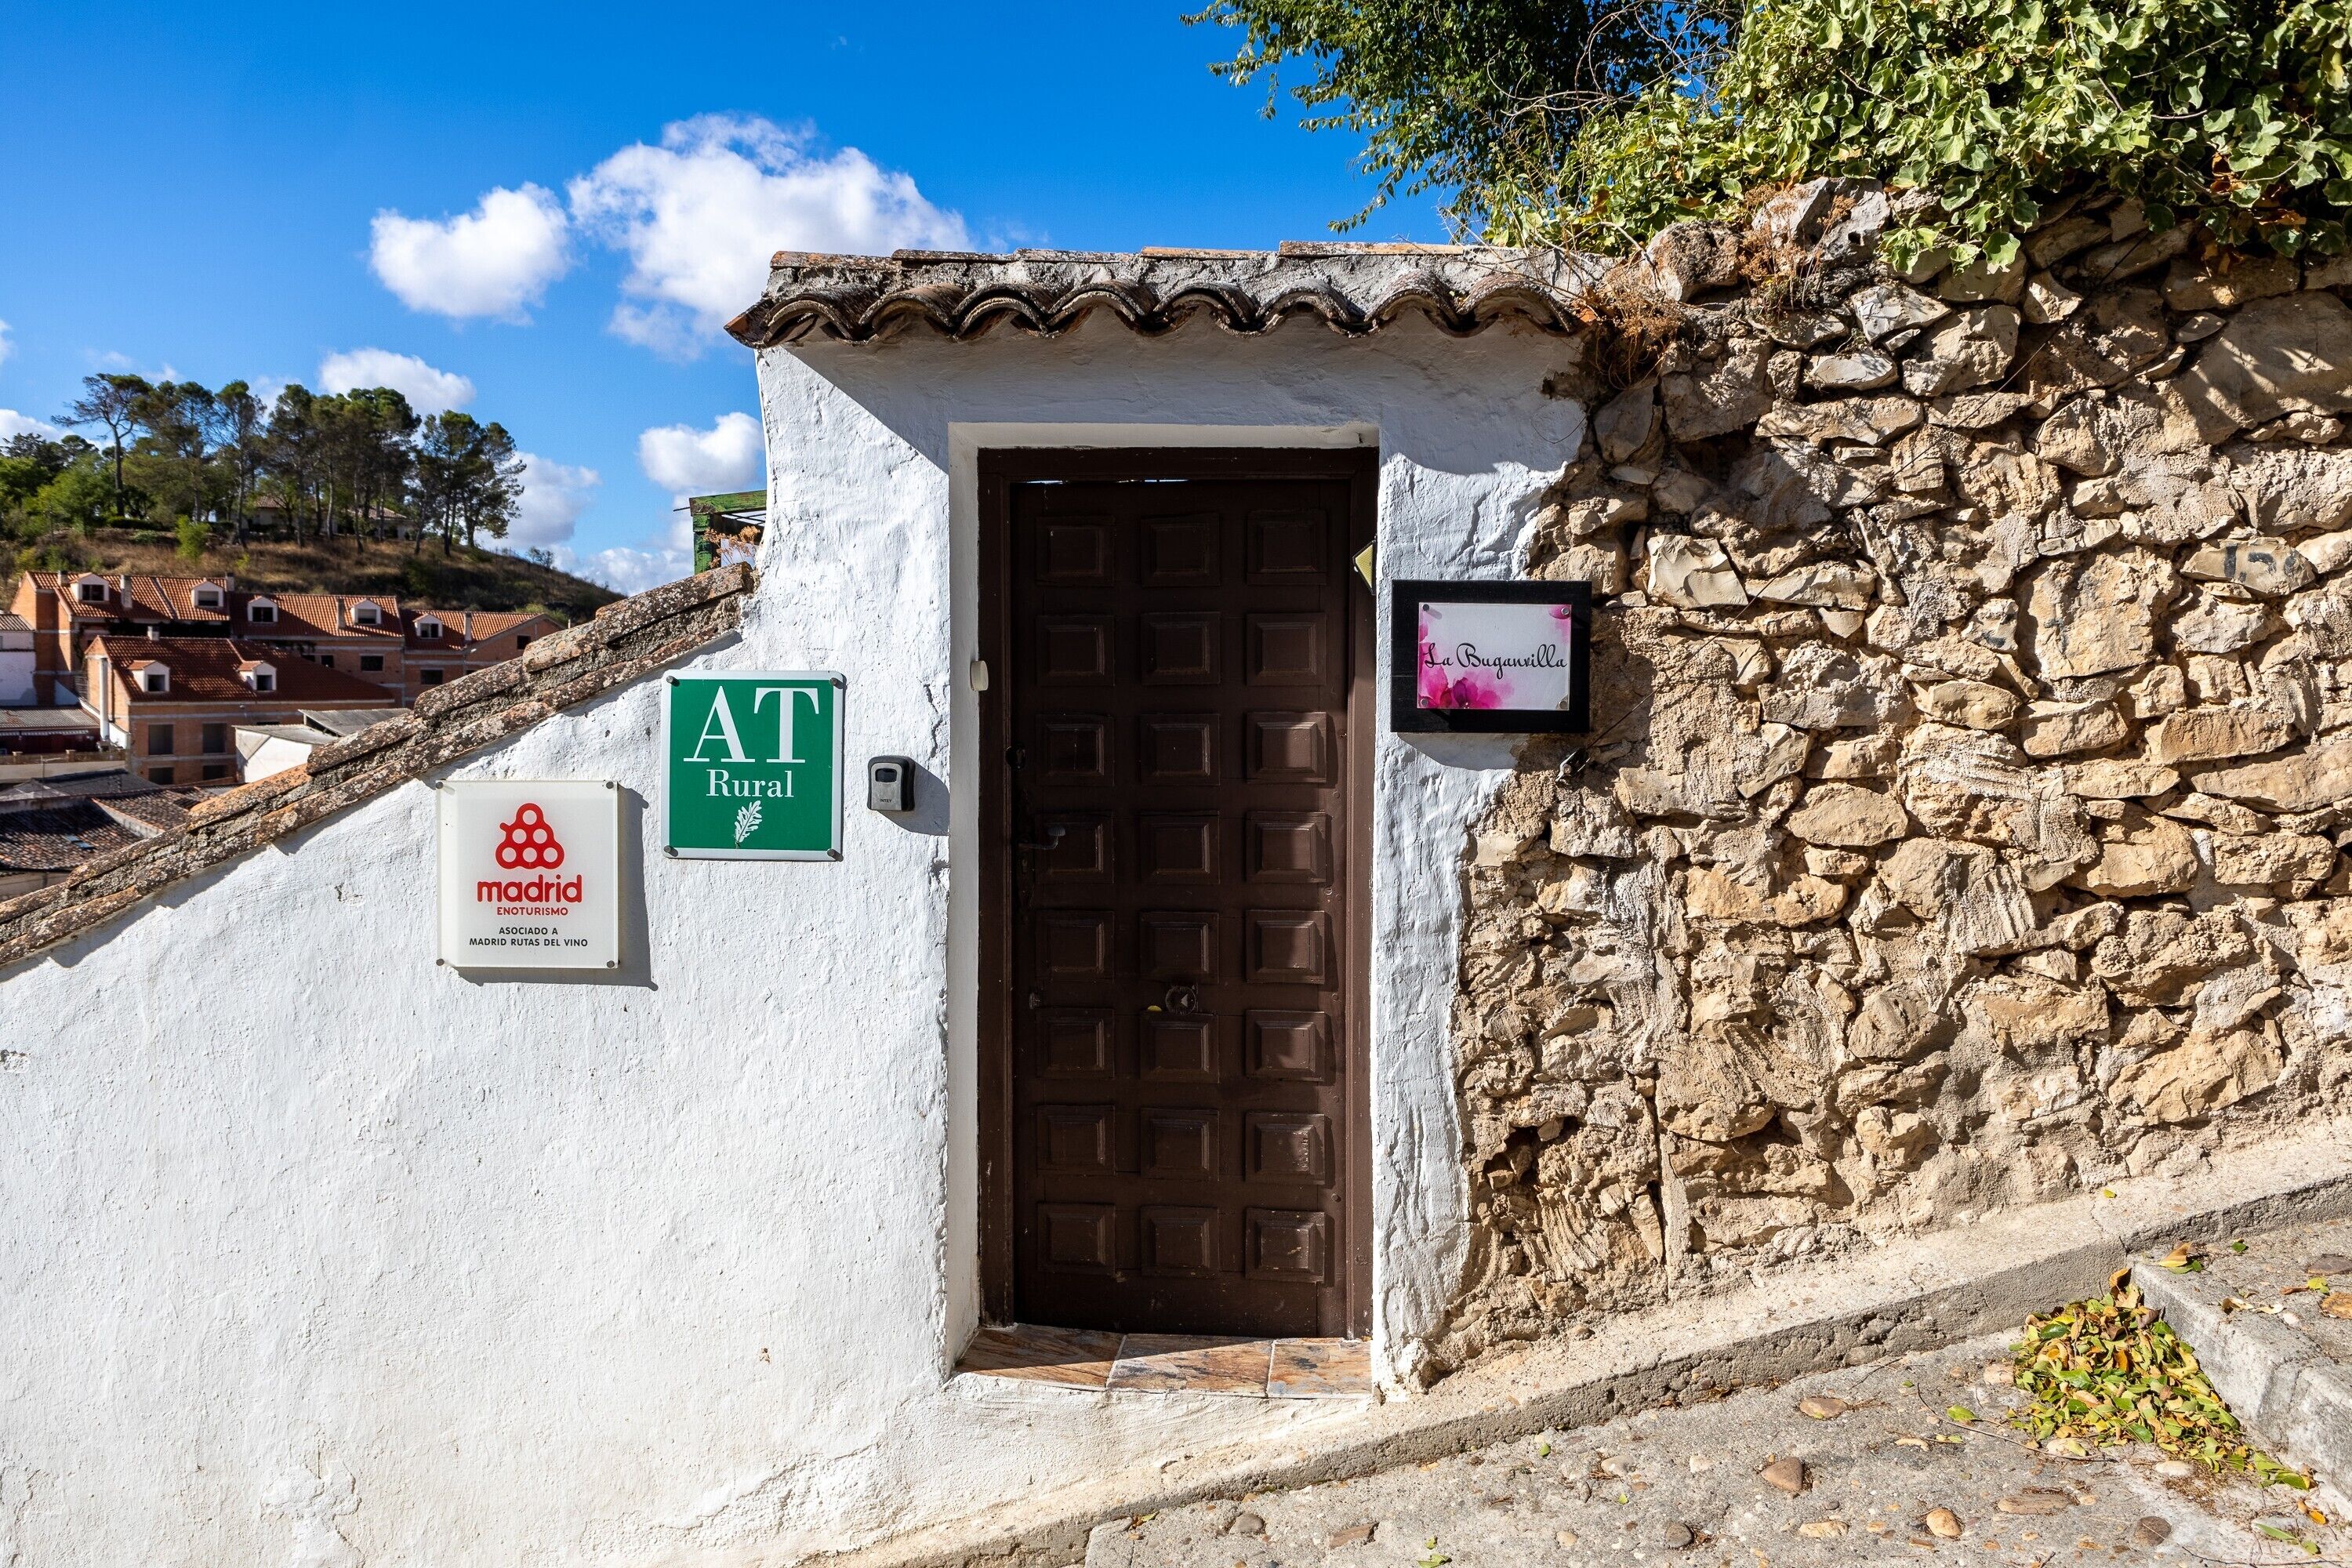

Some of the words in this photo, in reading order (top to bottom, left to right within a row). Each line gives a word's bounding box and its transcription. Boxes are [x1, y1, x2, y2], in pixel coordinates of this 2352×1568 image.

[1423, 642, 1454, 668] La
[1456, 642, 1568, 680] Buganvilla
[683, 684, 820, 764] AT
[706, 768, 795, 798] Rural
[477, 873, 583, 903] madrid
[496, 906, 568, 916] ENOTURISMO
[469, 938, 507, 946] MADRID
[499, 927, 548, 935] ASOCIADO
